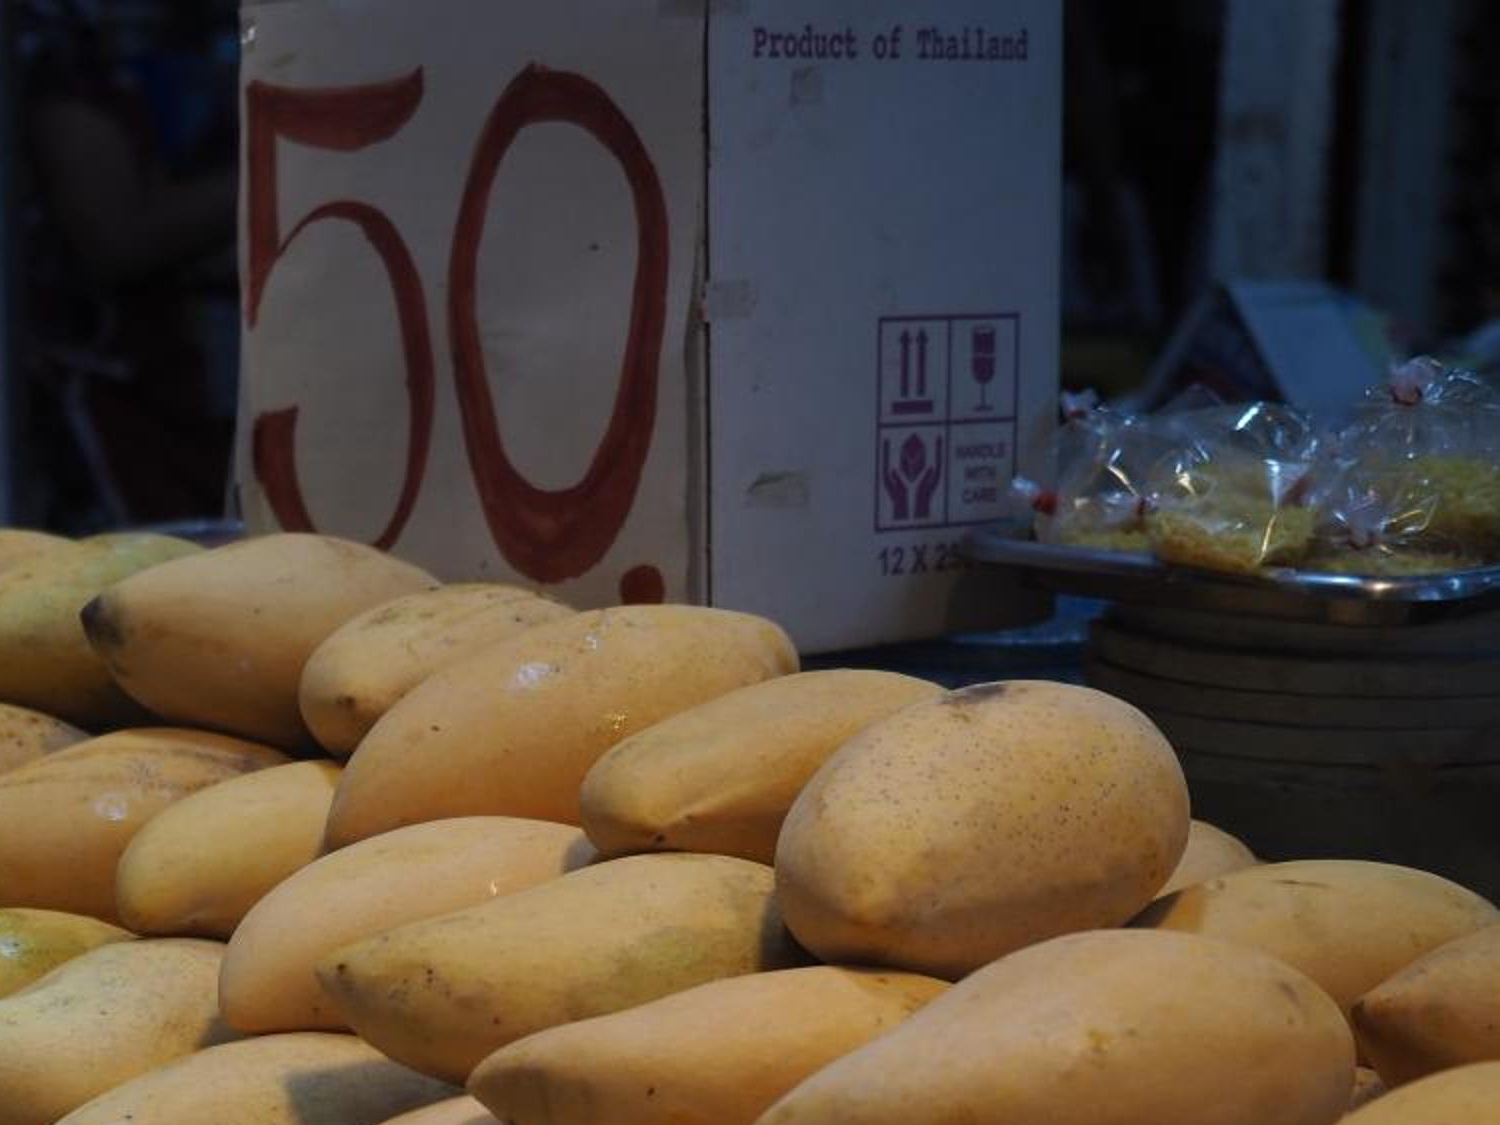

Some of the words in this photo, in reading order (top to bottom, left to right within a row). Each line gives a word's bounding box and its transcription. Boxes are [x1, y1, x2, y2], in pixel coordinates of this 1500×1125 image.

[753, 25, 858, 59] Product
[873, 25, 903, 60] of
[915, 27, 1029, 62] Thailand
[880, 546, 904, 576] 12
